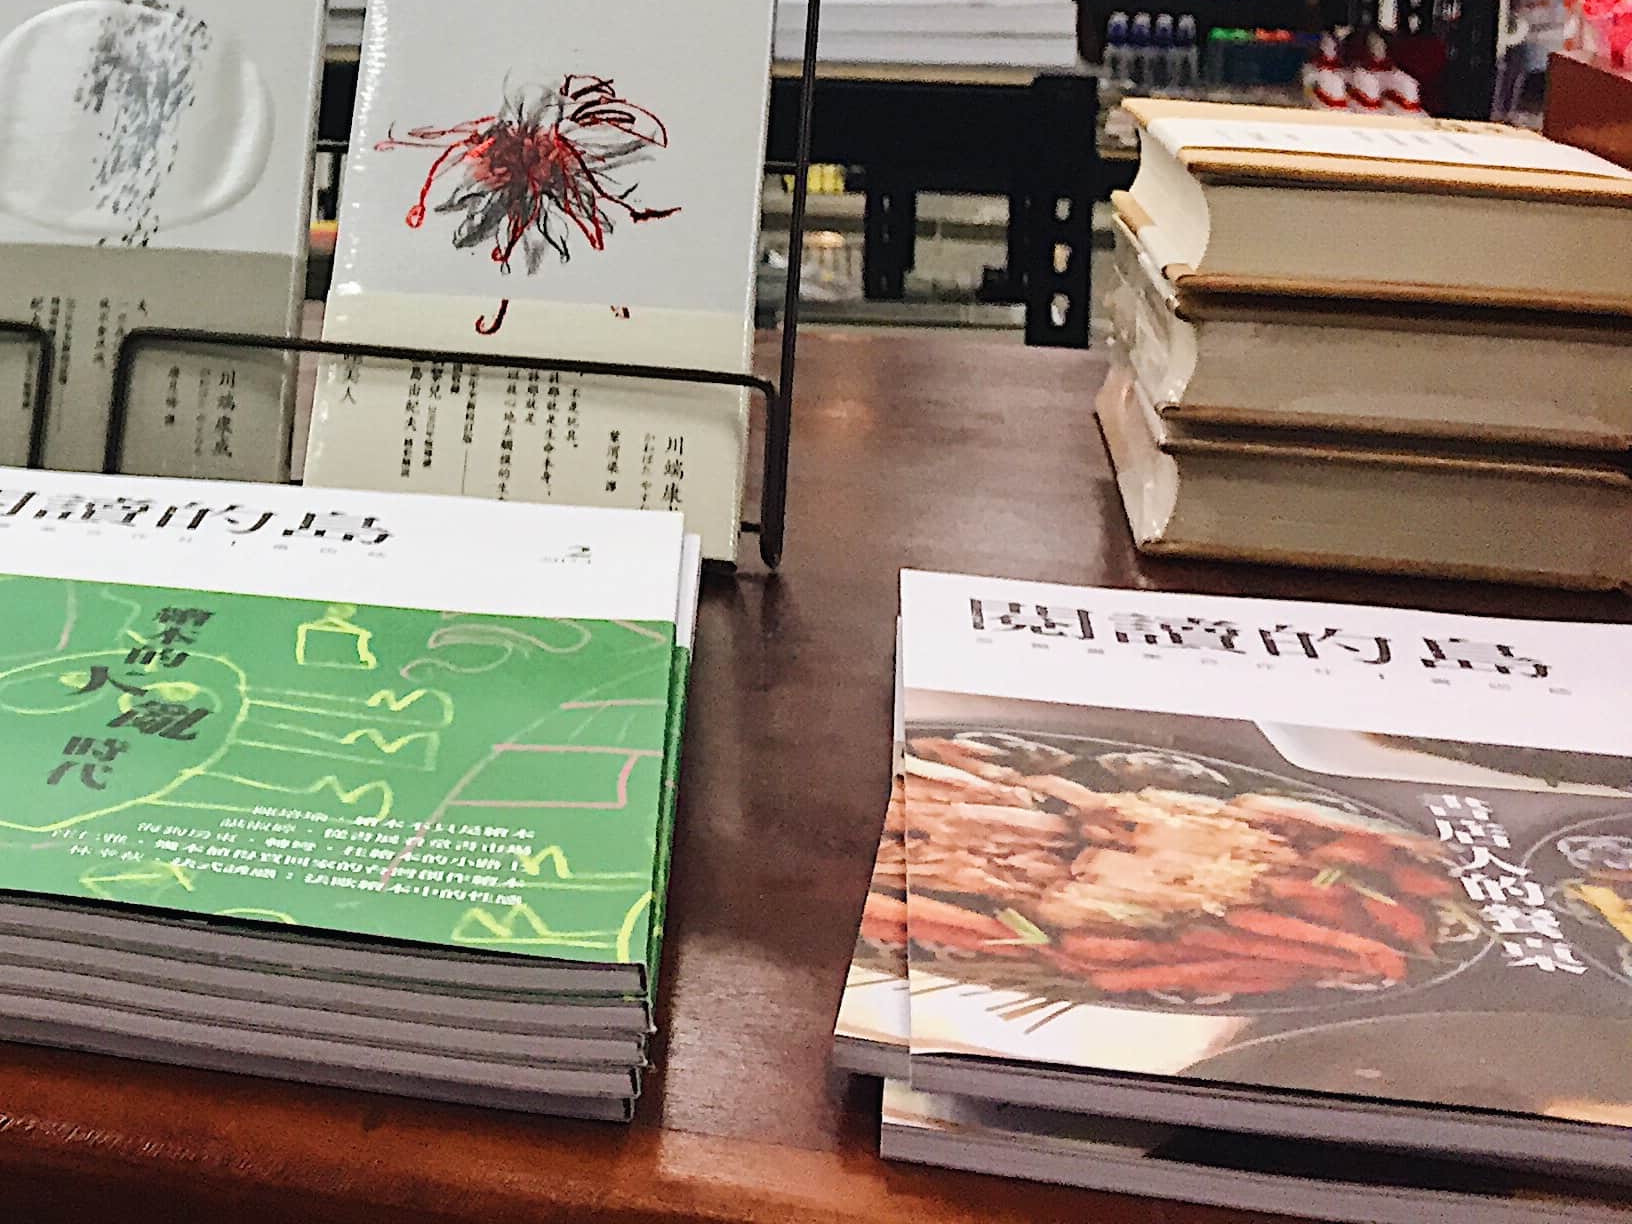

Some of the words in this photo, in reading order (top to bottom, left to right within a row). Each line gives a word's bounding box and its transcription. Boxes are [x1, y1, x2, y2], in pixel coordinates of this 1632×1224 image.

[213, 369, 236, 458] 川端康成
[662, 435, 684, 511] 川端康
[969, 597, 1552, 679] 閱讀的島
